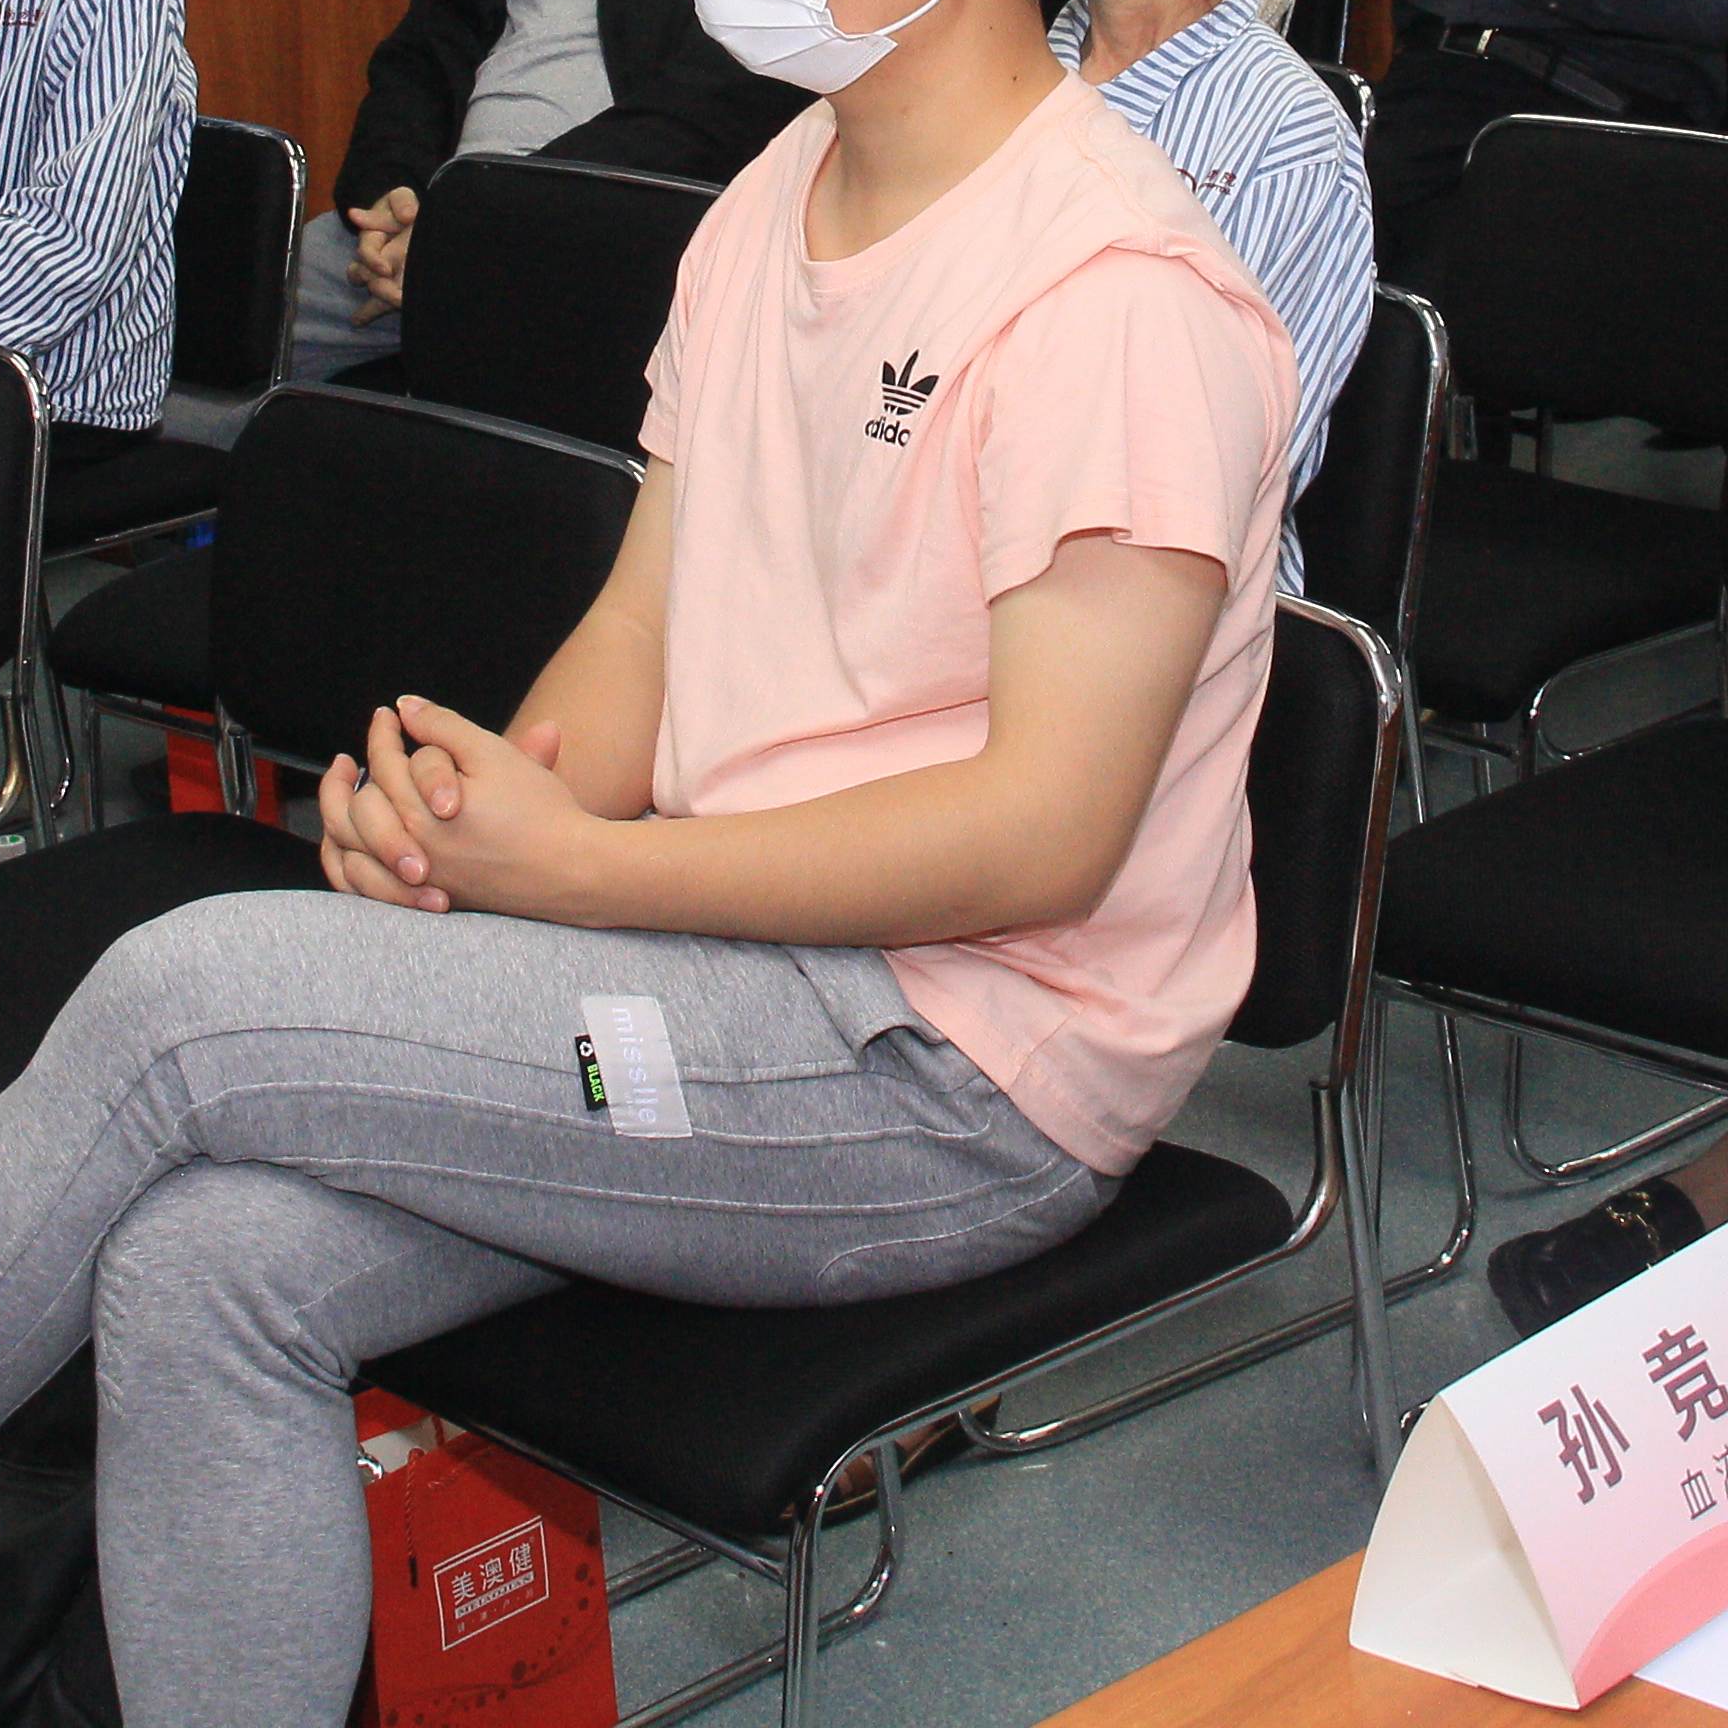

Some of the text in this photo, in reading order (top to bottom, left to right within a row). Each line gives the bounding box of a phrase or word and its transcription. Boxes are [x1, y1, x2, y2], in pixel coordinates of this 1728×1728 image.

[586, 1063, 605, 1102] BLACK
[452, 1542, 533, 1606] 美澳健
